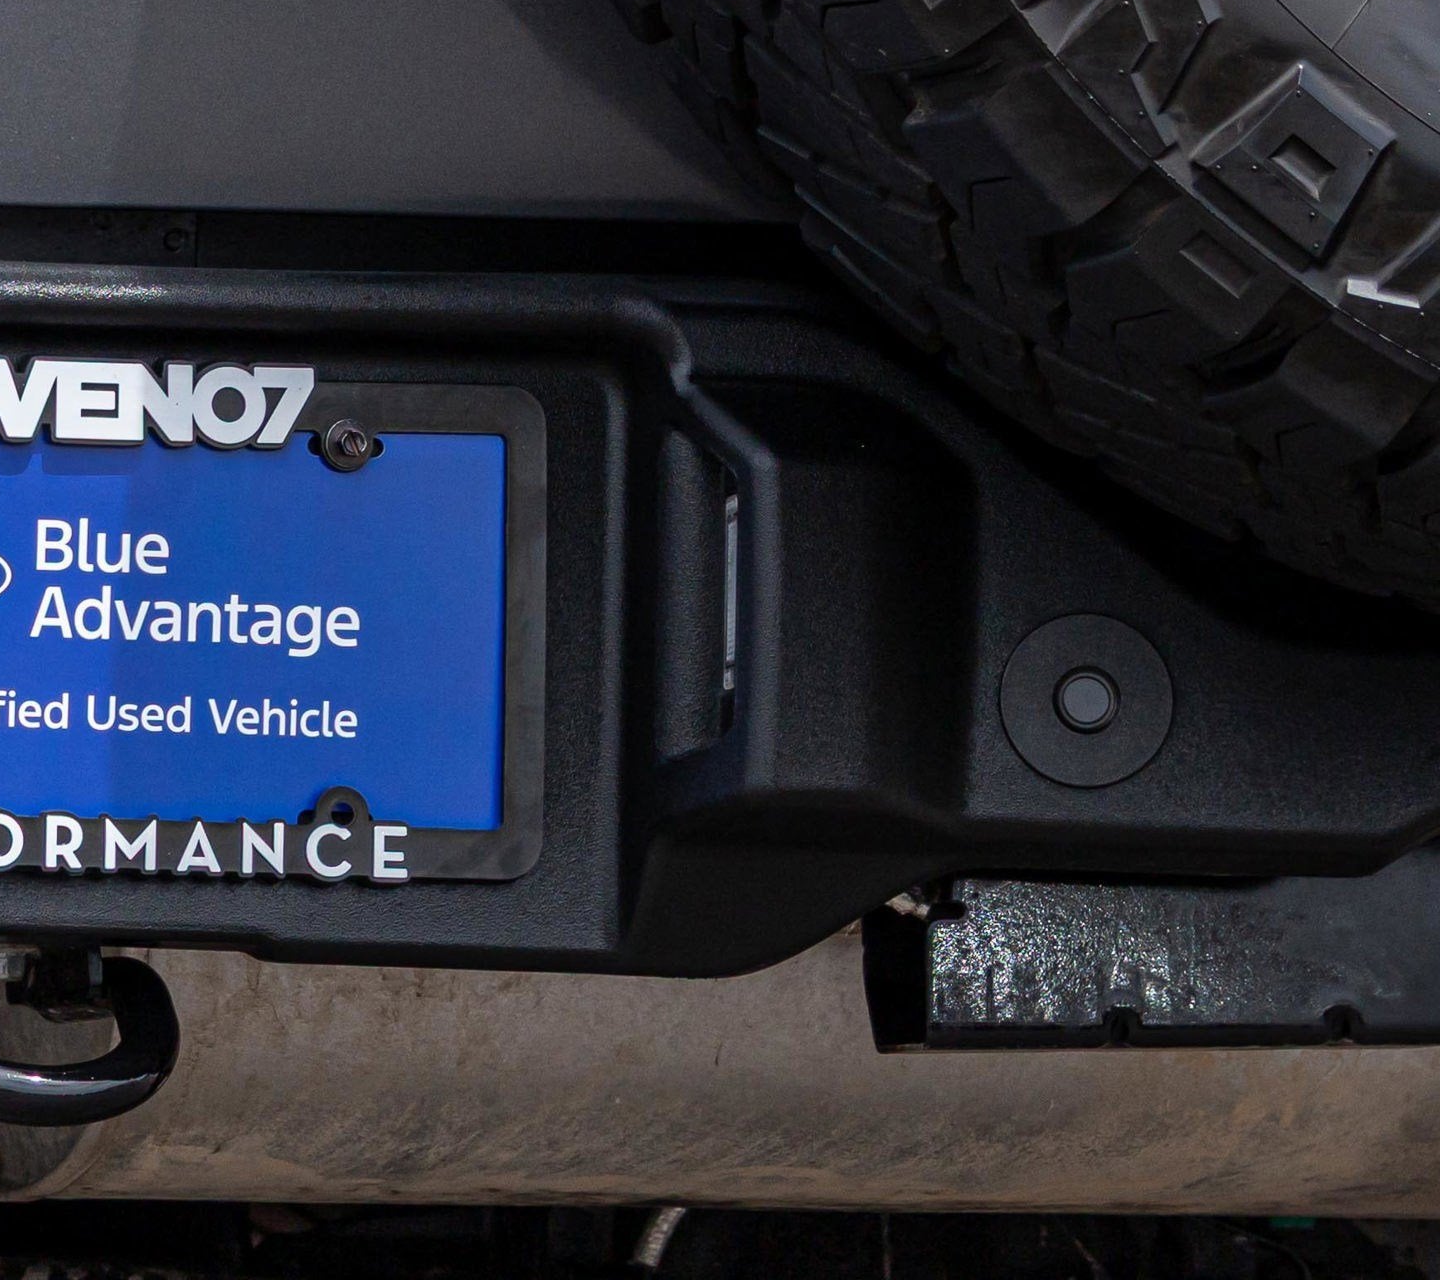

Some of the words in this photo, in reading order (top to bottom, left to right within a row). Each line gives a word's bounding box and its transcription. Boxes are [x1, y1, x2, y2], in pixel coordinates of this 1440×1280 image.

[35, 517, 170, 575] Blue
[29, 585, 361, 658] Advantage
[87, 695, 192, 734] Used
[207, 698, 358, 738] Vehicle
